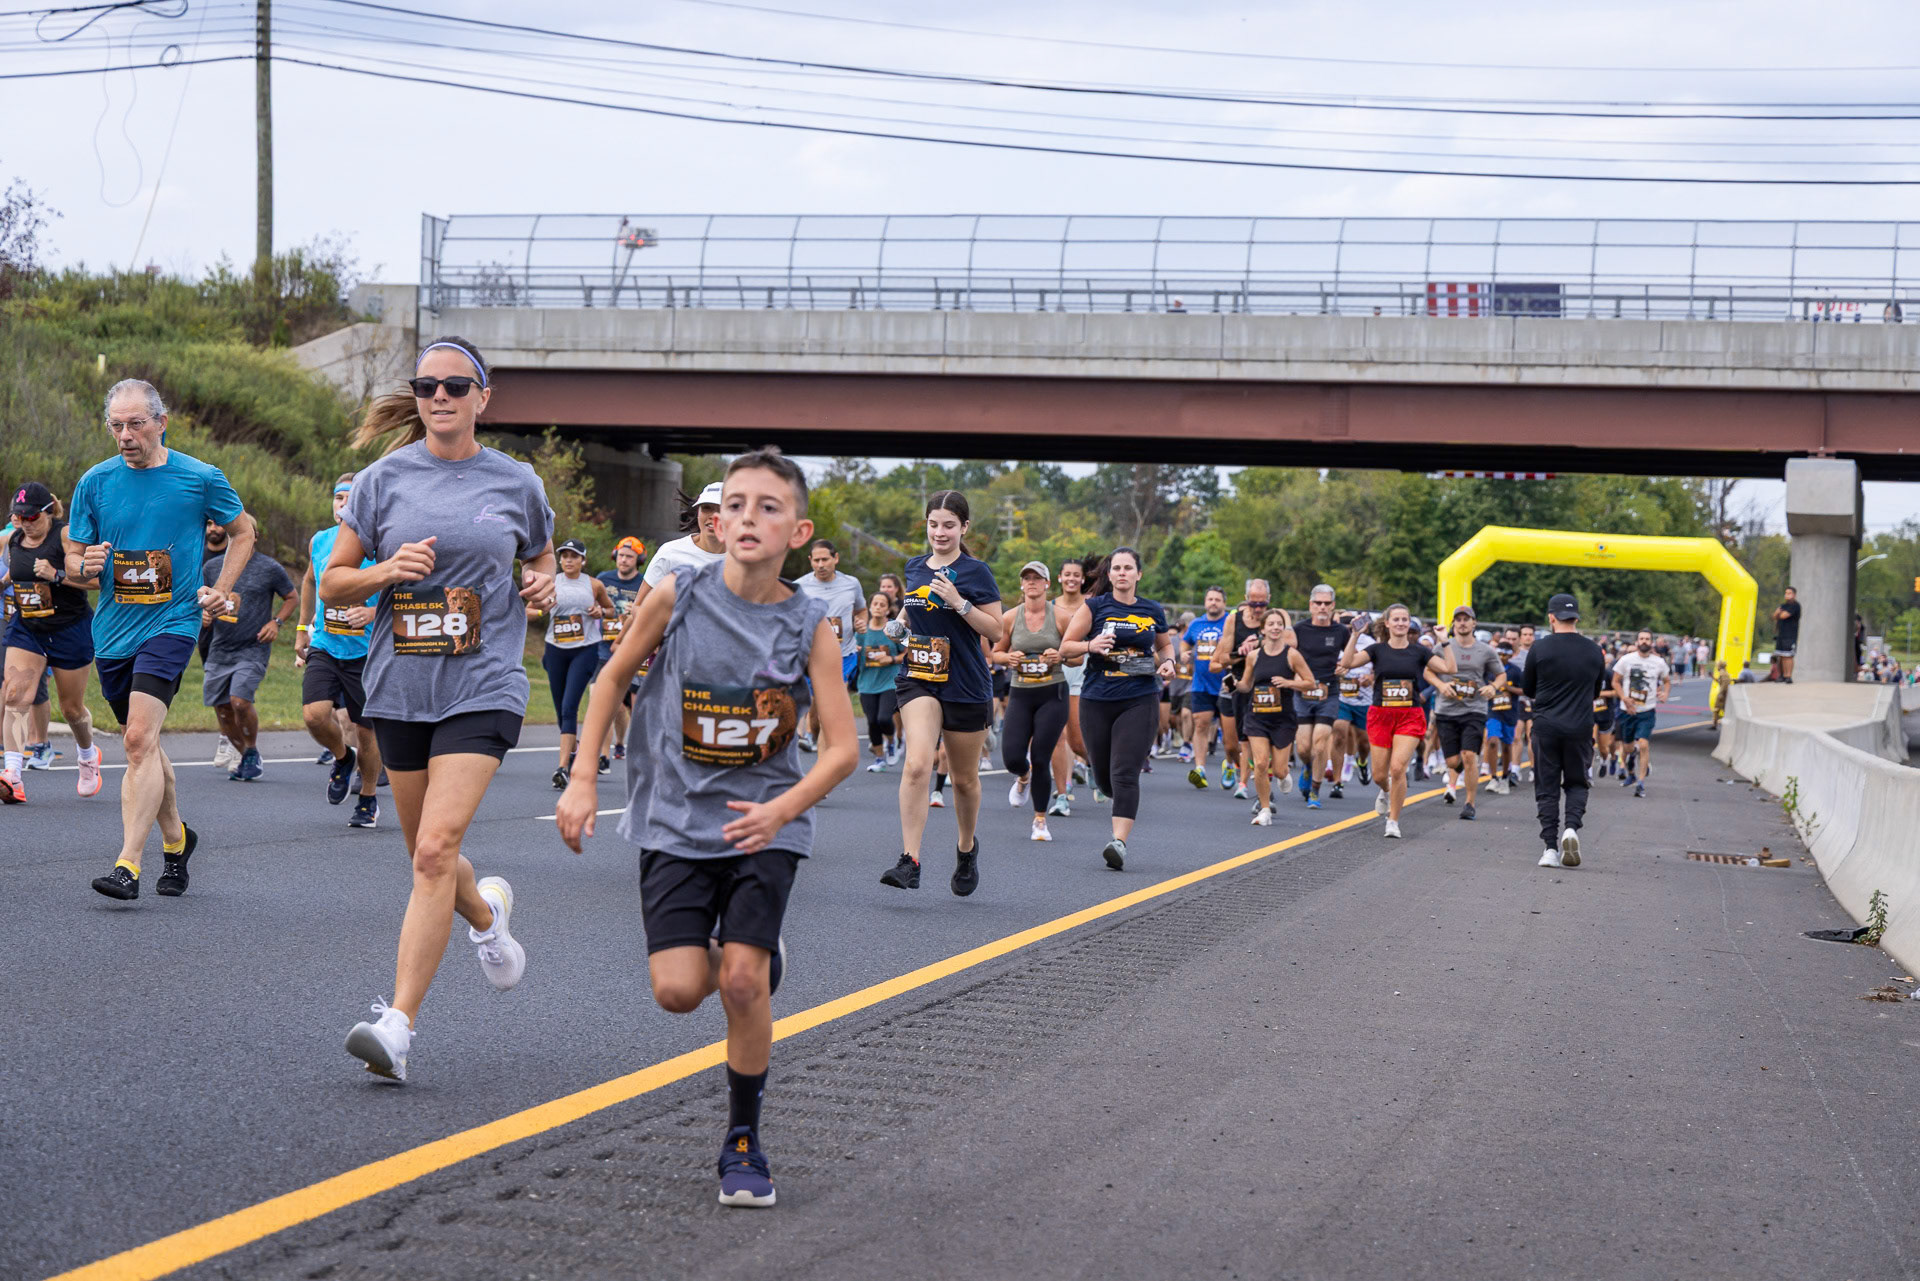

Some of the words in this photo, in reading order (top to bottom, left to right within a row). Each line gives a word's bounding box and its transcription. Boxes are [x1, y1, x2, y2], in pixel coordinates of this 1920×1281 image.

[123, 568, 158, 583] 44
[20, 594, 41, 605] 72
[402, 613, 468, 637] 128
[554, 622, 581, 634] 280
[606, 621, 623, 631] 74
[911, 649, 942, 665] 193
[1021, 663, 1048, 673] 133
[684, 689, 711, 699] THE
[1386, 688, 1408, 697] 170
[1257, 694, 1275, 703] 171
[683, 702, 730, 714] CHASE
[731, 706, 752, 715] 5K
[697, 716, 779, 746] 127
